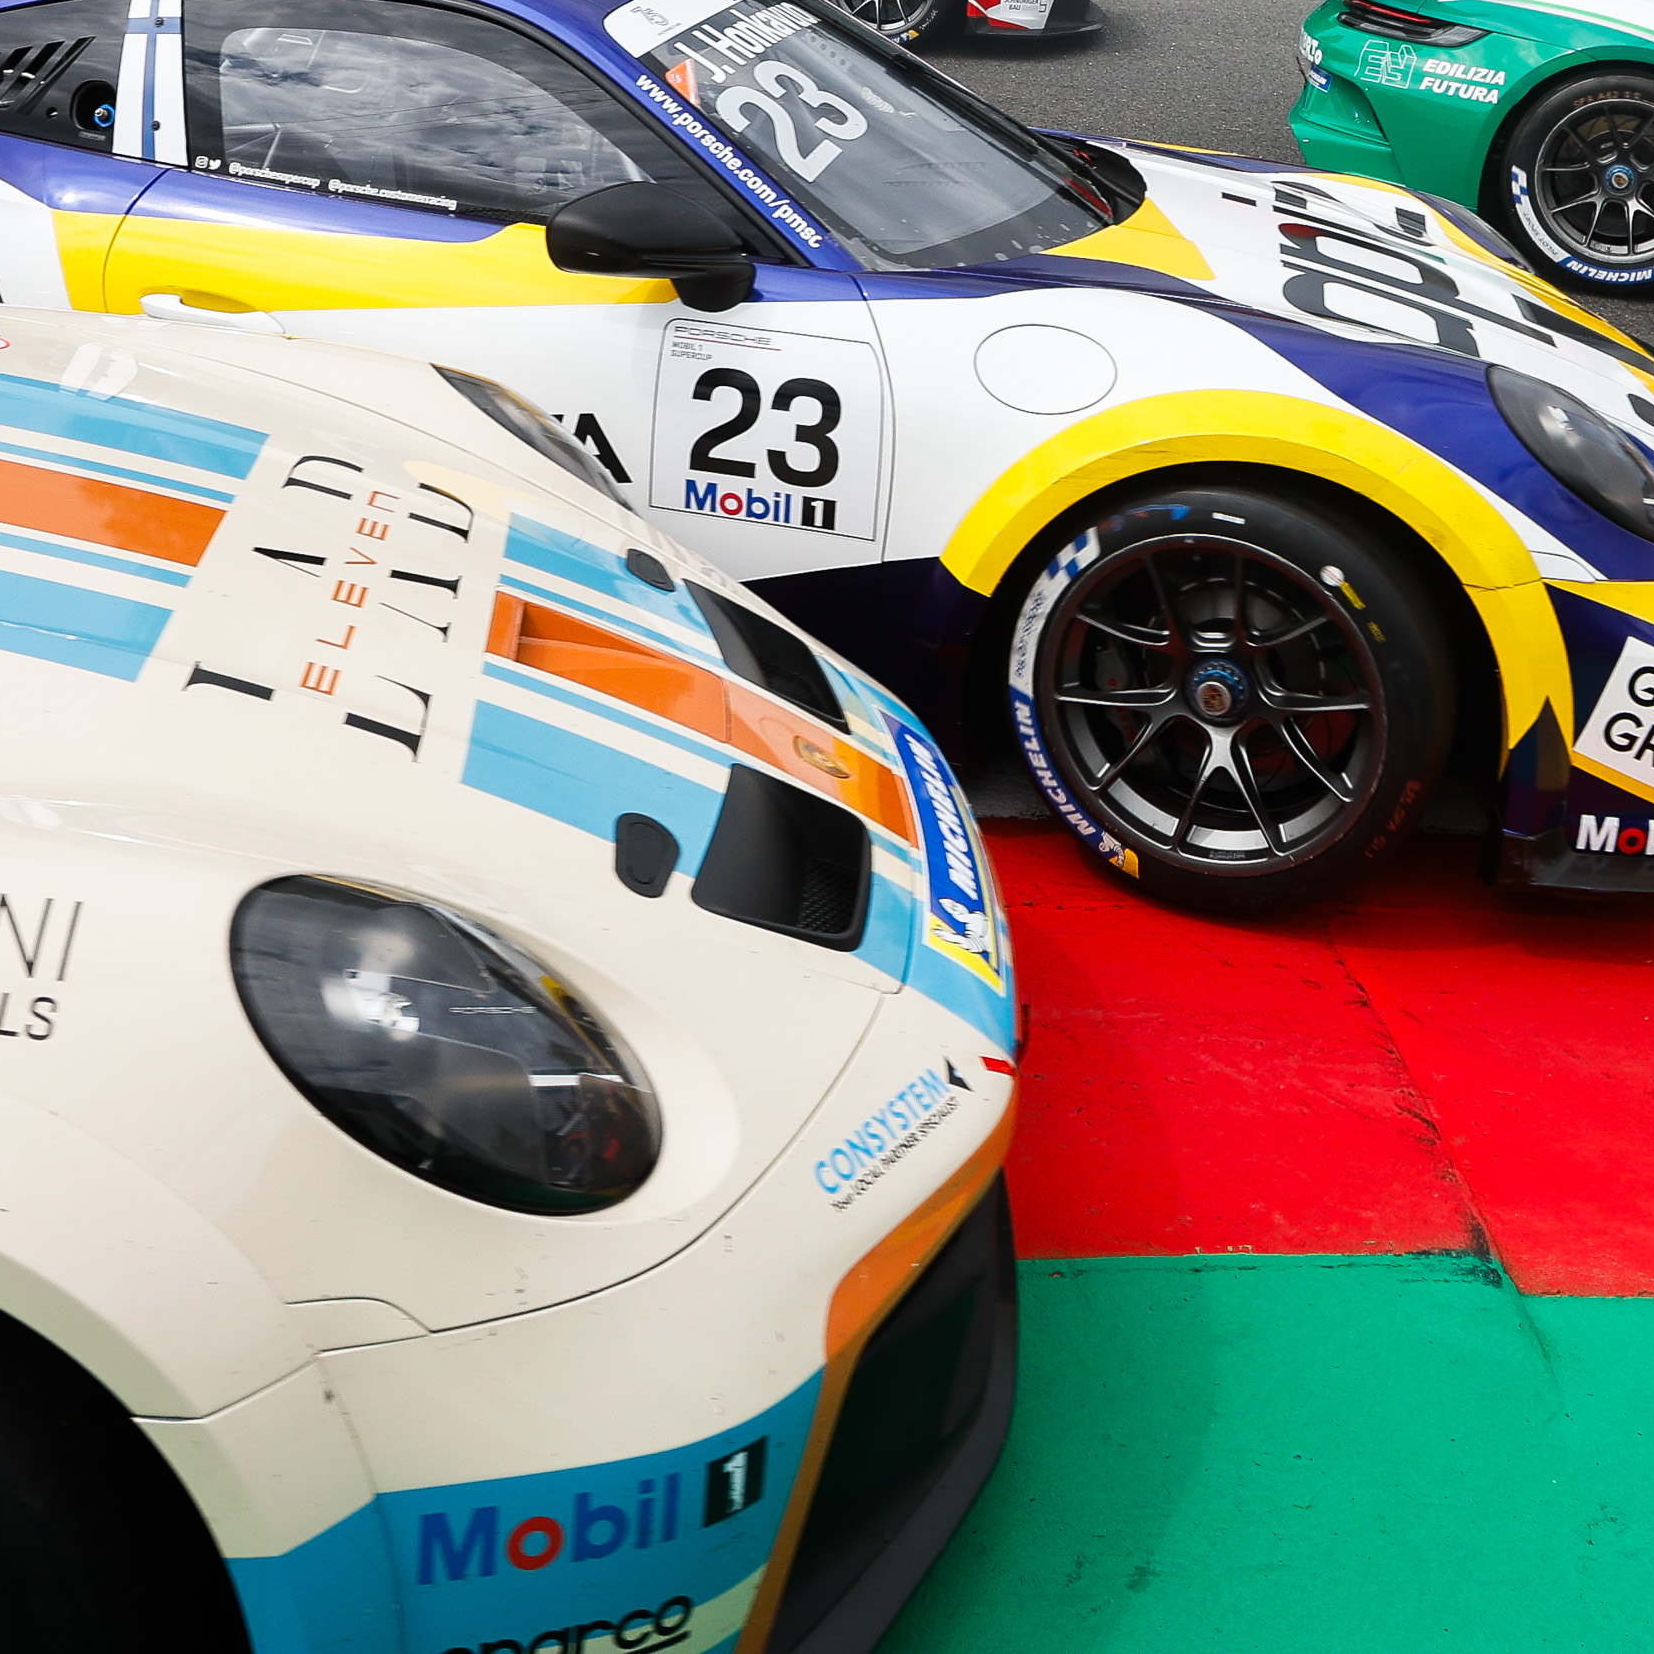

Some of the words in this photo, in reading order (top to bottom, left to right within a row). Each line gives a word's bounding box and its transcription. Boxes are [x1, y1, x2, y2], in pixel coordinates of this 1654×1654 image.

[673, 41, 737, 84] J.
[1419, 76, 1501, 105] FUTURA
[1422, 58, 1506, 86] EDILIZIA
[635, 74, 824, 249] www.porsche.com/pmsc
[715, 59, 869, 183] 23
[1566, 259, 1653, 282] MICHELIN
[670, 350, 713, 361] SUPERCUP
[673, 325, 772, 346] PORSCHE
[689, 367, 841, 488] 23
[685, 479, 792, 524] Mobil
[299, 488, 402, 696] ELEVEN
[1013, 699, 1098, 837] MICHELIN
[905, 732, 986, 902] MICHELIN
[816, 1068, 951, 1195] CONSYSTEM
[415, 1471, 682, 1587] Mobil
[439, 1594, 694, 1654] parco
